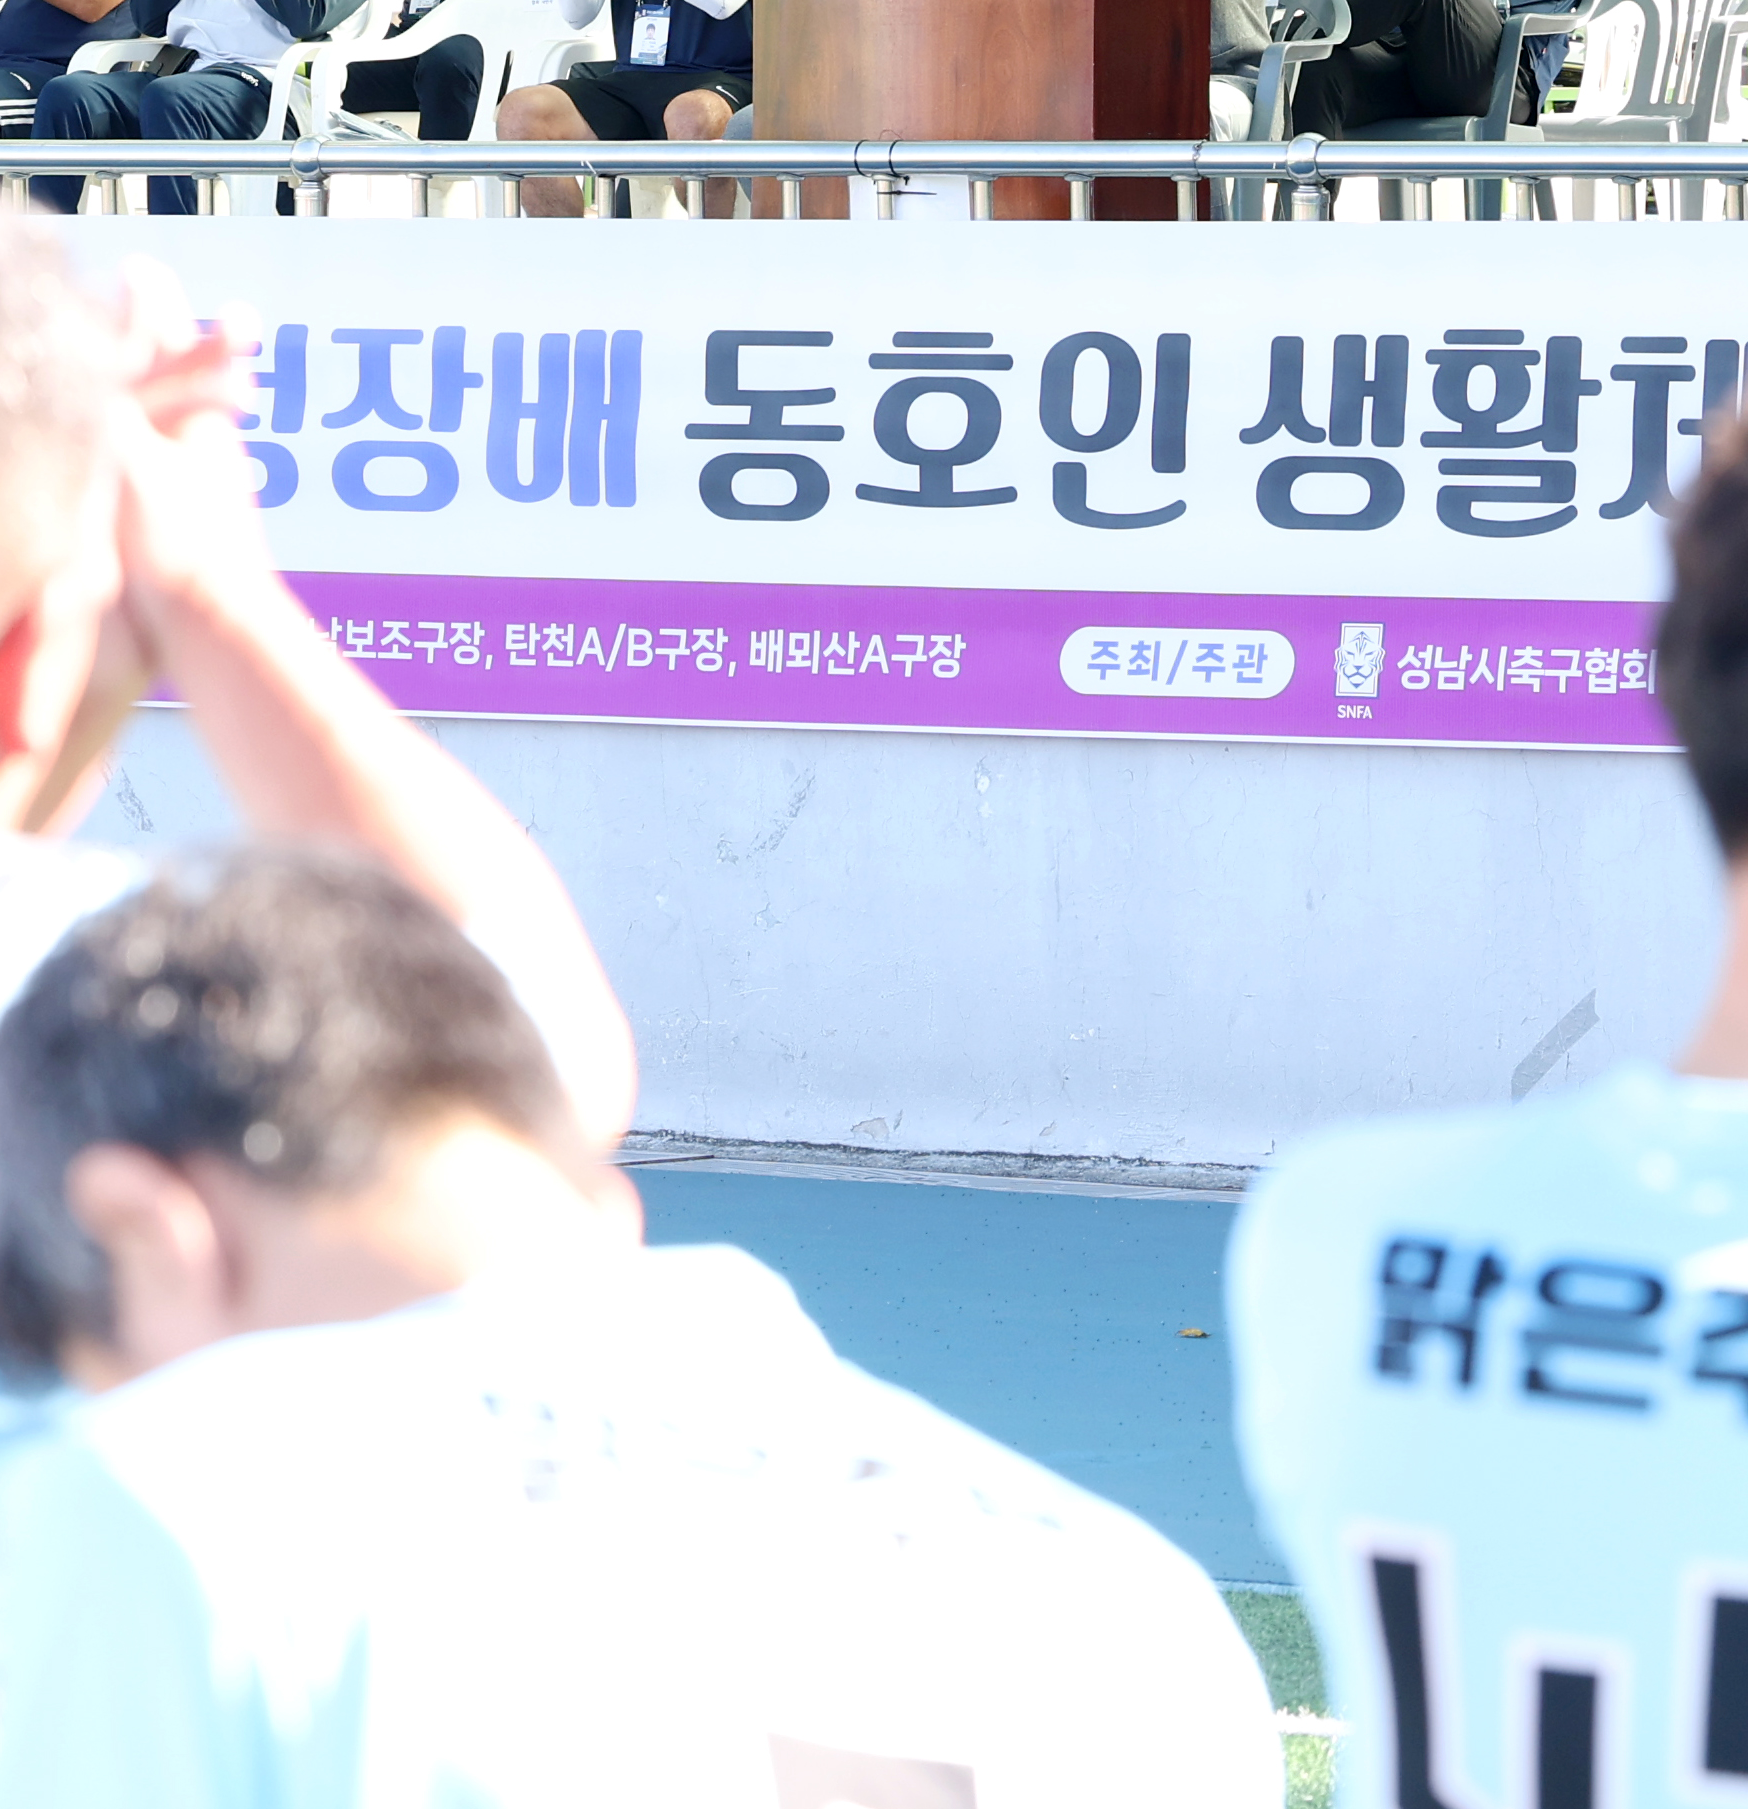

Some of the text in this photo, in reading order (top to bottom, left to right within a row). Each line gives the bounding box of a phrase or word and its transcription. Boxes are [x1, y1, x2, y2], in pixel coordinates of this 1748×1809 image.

[683, 329, 1193, 531] 동호인
[502, 623, 737, 678] 탄천A/B구장,
[748, 629, 968, 680] 배뫼산A구장
[1085, 638, 1270, 686] 주최/주관
[1396, 644, 1656, 694] 성남시축구협회
[1336, 704, 1374, 720] SNFA
